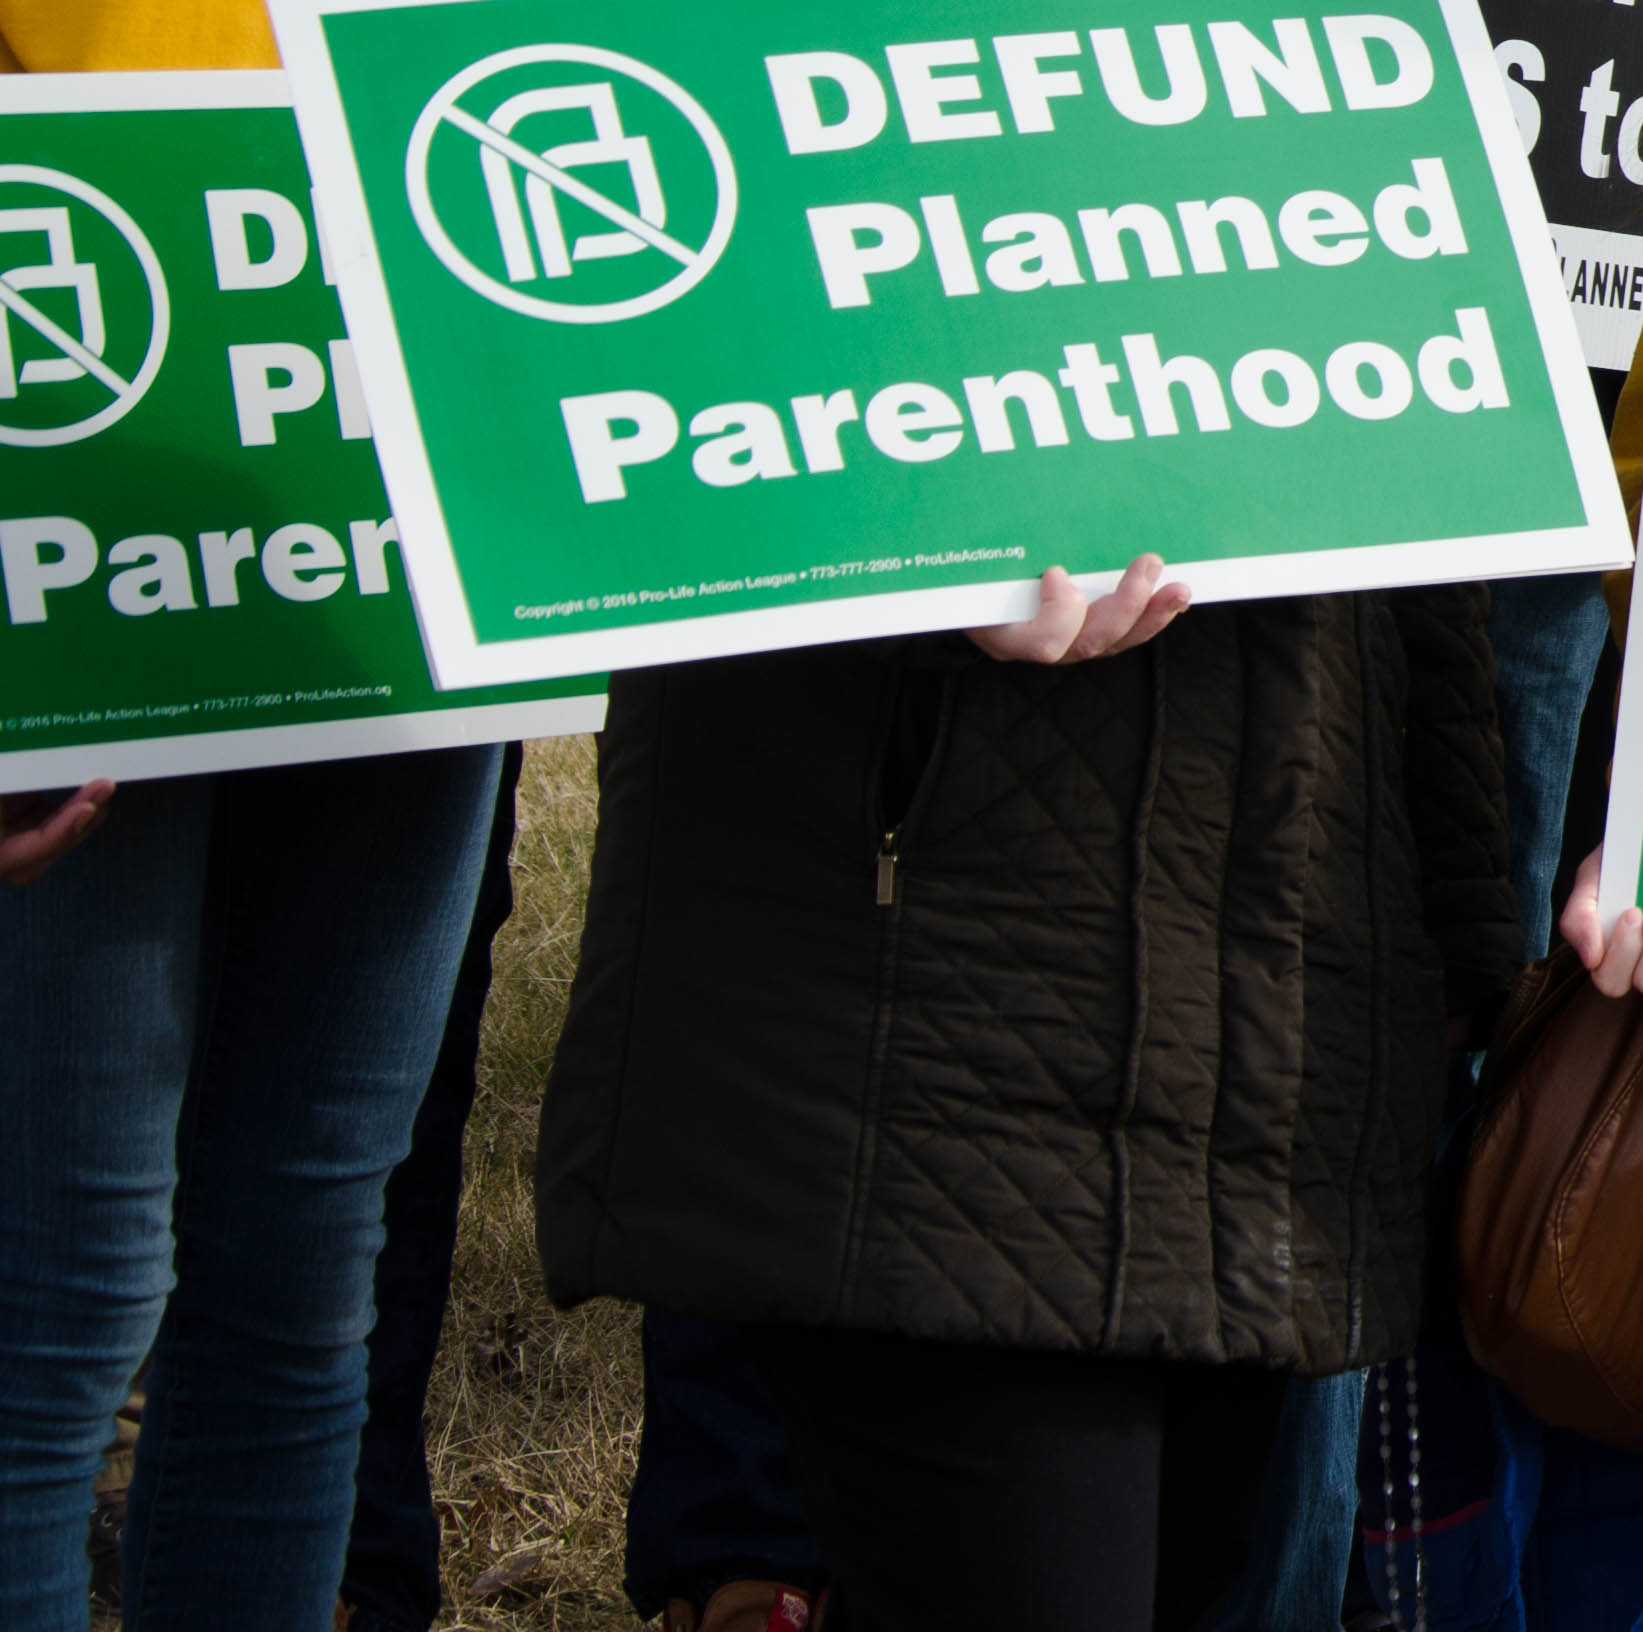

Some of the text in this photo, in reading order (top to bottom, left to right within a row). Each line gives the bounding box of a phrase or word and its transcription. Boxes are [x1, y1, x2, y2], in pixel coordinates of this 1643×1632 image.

[764, 13, 1434, 156] DEFUND
[204, 188, 337, 291] D
[805, 156, 1470, 310] Planned
[561, 306, 1511, 504] Parenthood
[514, 598, 584, 620] Copyright
[602, 592, 638, 609] 2016
[639, 584, 695, 605] Pro-Life
[698, 578, 743, 596] Action
[745, 572, 796, 589] League
[810, 557, 901, 580] 773-777-2900
[104, 706, 143, 721] Action
[146, 703, 190, 719] League
